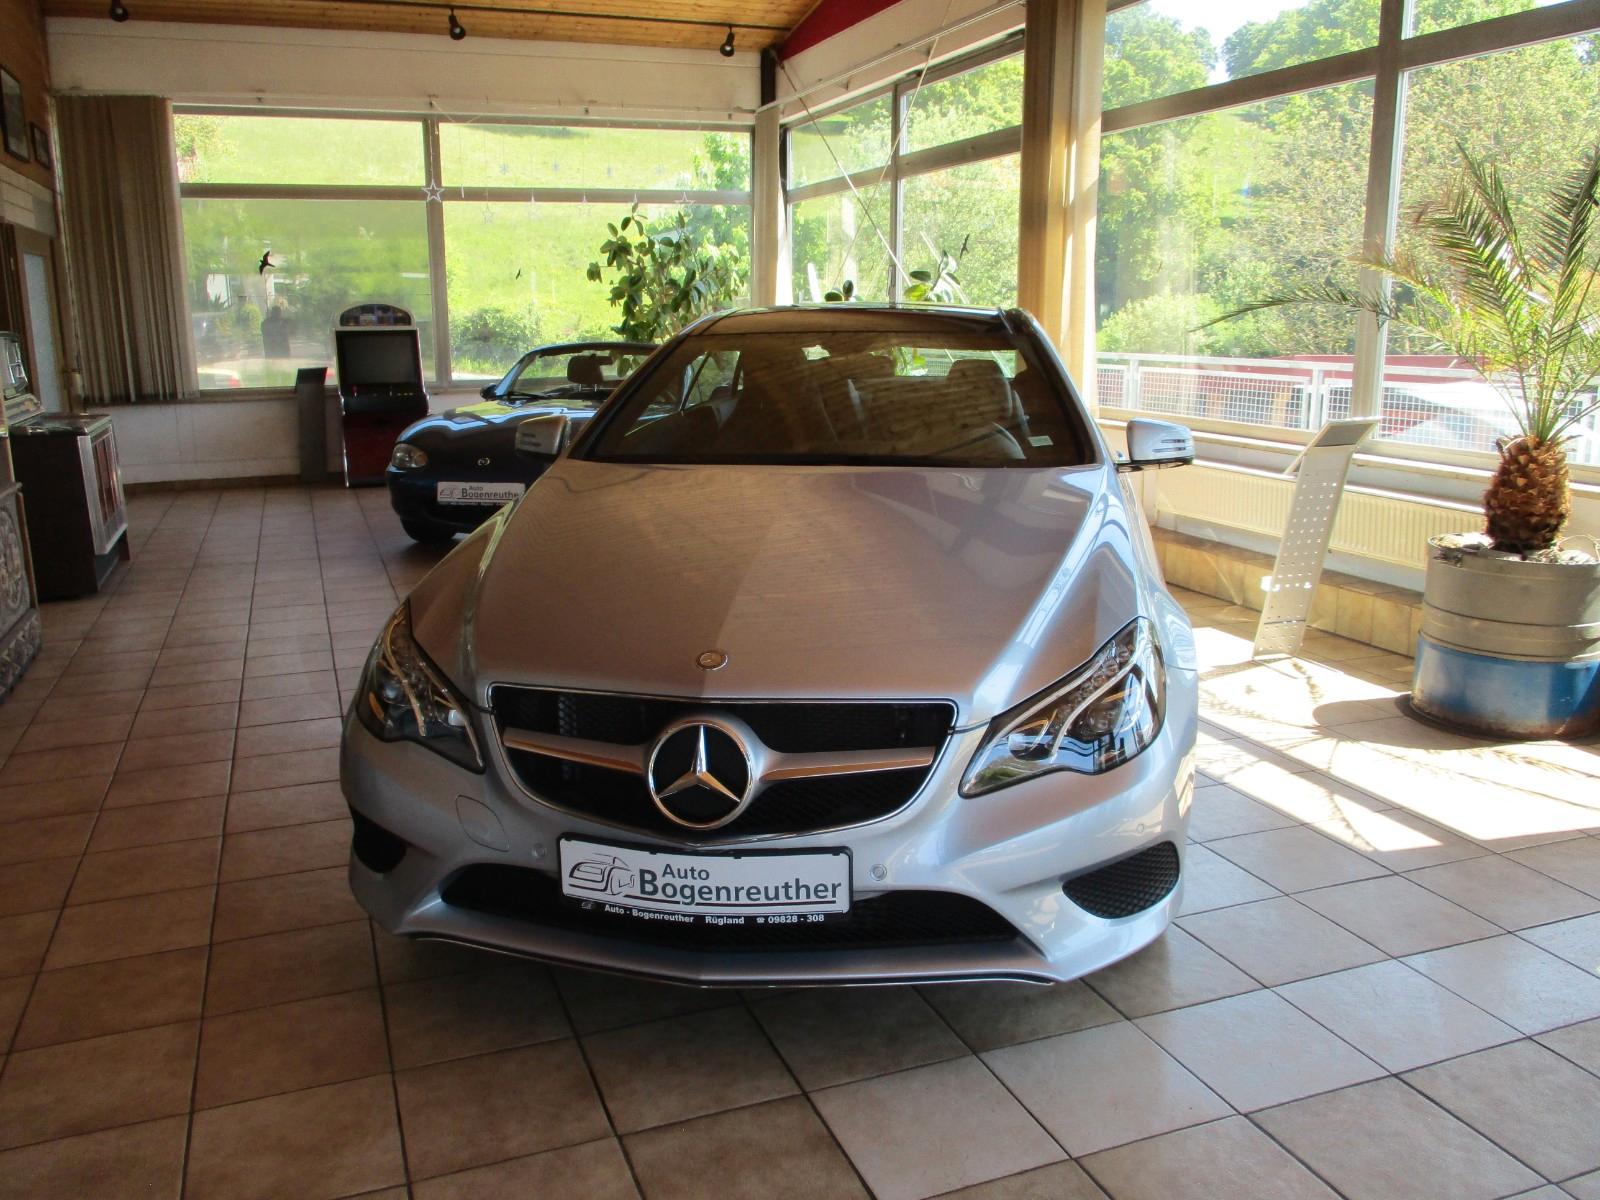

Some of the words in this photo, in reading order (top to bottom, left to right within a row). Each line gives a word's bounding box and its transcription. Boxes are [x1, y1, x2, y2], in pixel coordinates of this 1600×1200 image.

[461, 487, 520, 499] Bogenreuthe
[661, 863, 710, 880] Auto
[639, 868, 842, 906] Bogenreuther
[604, 904, 625, 914] Auto
[631, 908, 694, 923] Bogenreuther
[705, 915, 745, 926] Rügland
[767, 915, 798, 924] 09828
[806, 914, 825, 922] 308
